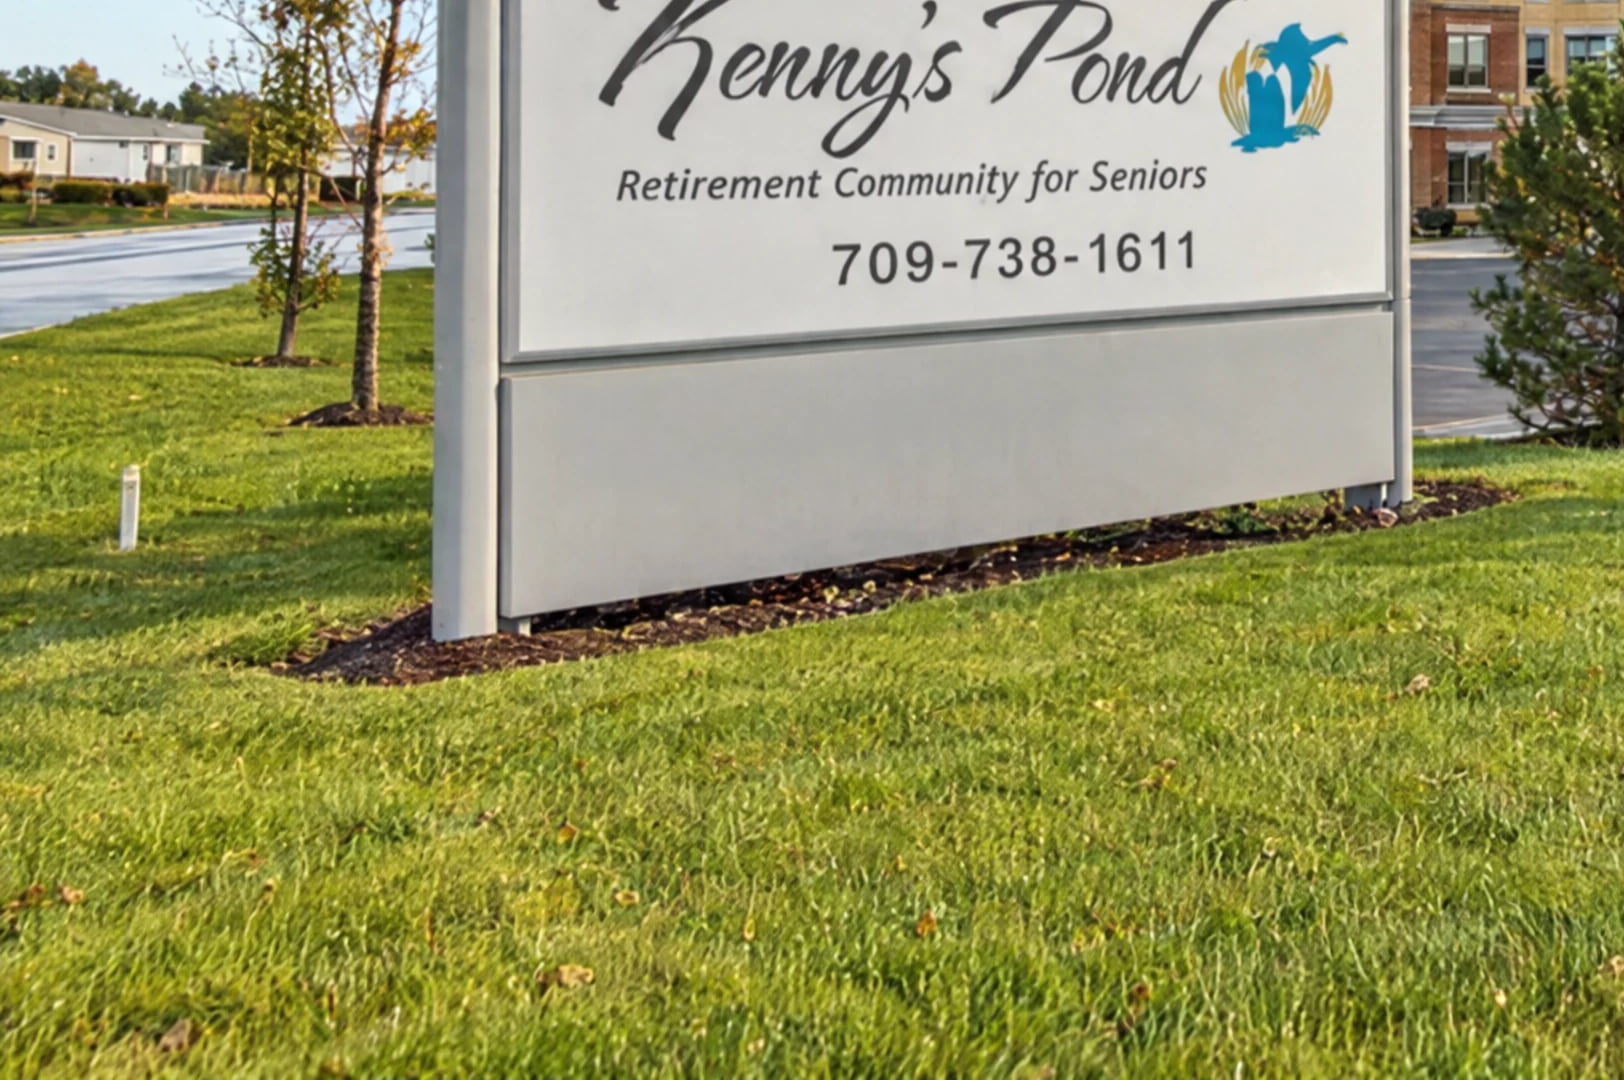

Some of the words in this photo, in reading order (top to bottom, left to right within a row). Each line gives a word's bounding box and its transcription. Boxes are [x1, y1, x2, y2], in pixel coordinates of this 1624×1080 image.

[616, 167, 821, 202] Retirement
[833, 166, 1019, 205] Community
[1024, 159, 1079, 204] for
[1089, 159, 1208, 193] Seniors
[832, 230, 1194, 287] 709-738-1611
